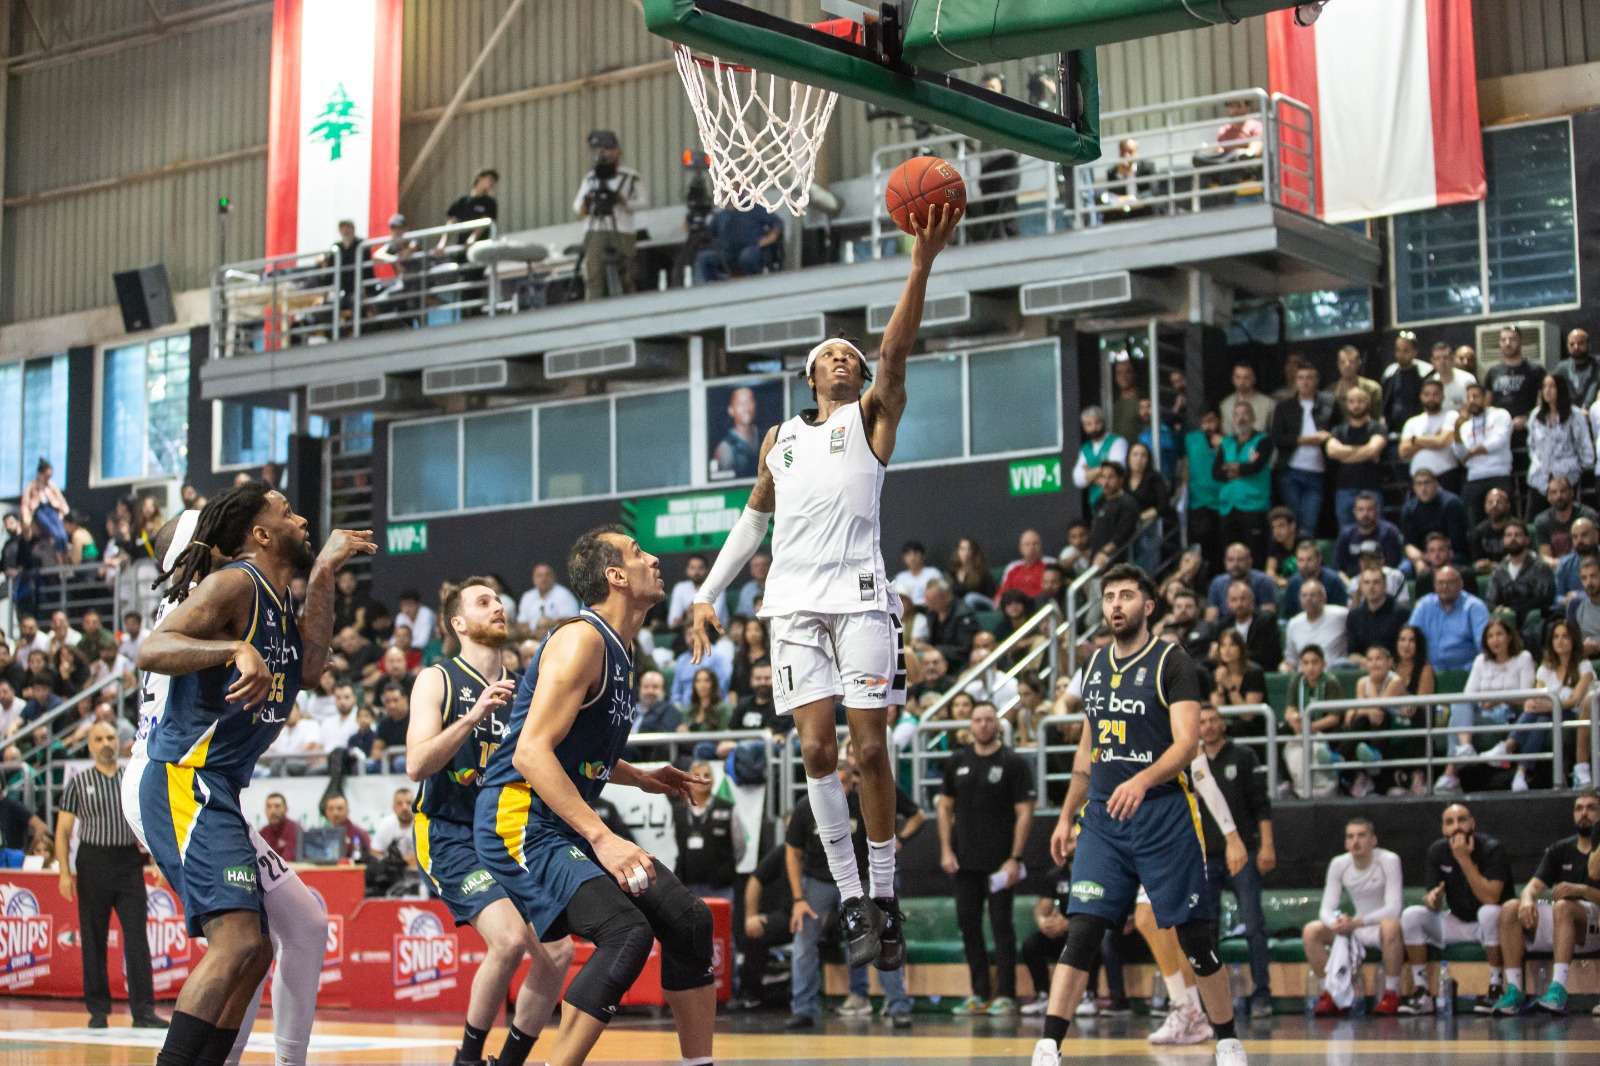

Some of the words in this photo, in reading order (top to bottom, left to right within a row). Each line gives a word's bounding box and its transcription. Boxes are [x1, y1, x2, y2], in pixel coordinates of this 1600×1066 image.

[1010, 462, 1061, 491] VVIP-1
[1108, 691, 1146, 716] bcn
[1098, 719, 1127, 745] 24
[257, 850, 289, 882] 22
[0, 920, 48, 959] SNIPS
[146, 921, 186, 957] NIPS
[399, 939, 454, 975] SNIPS
